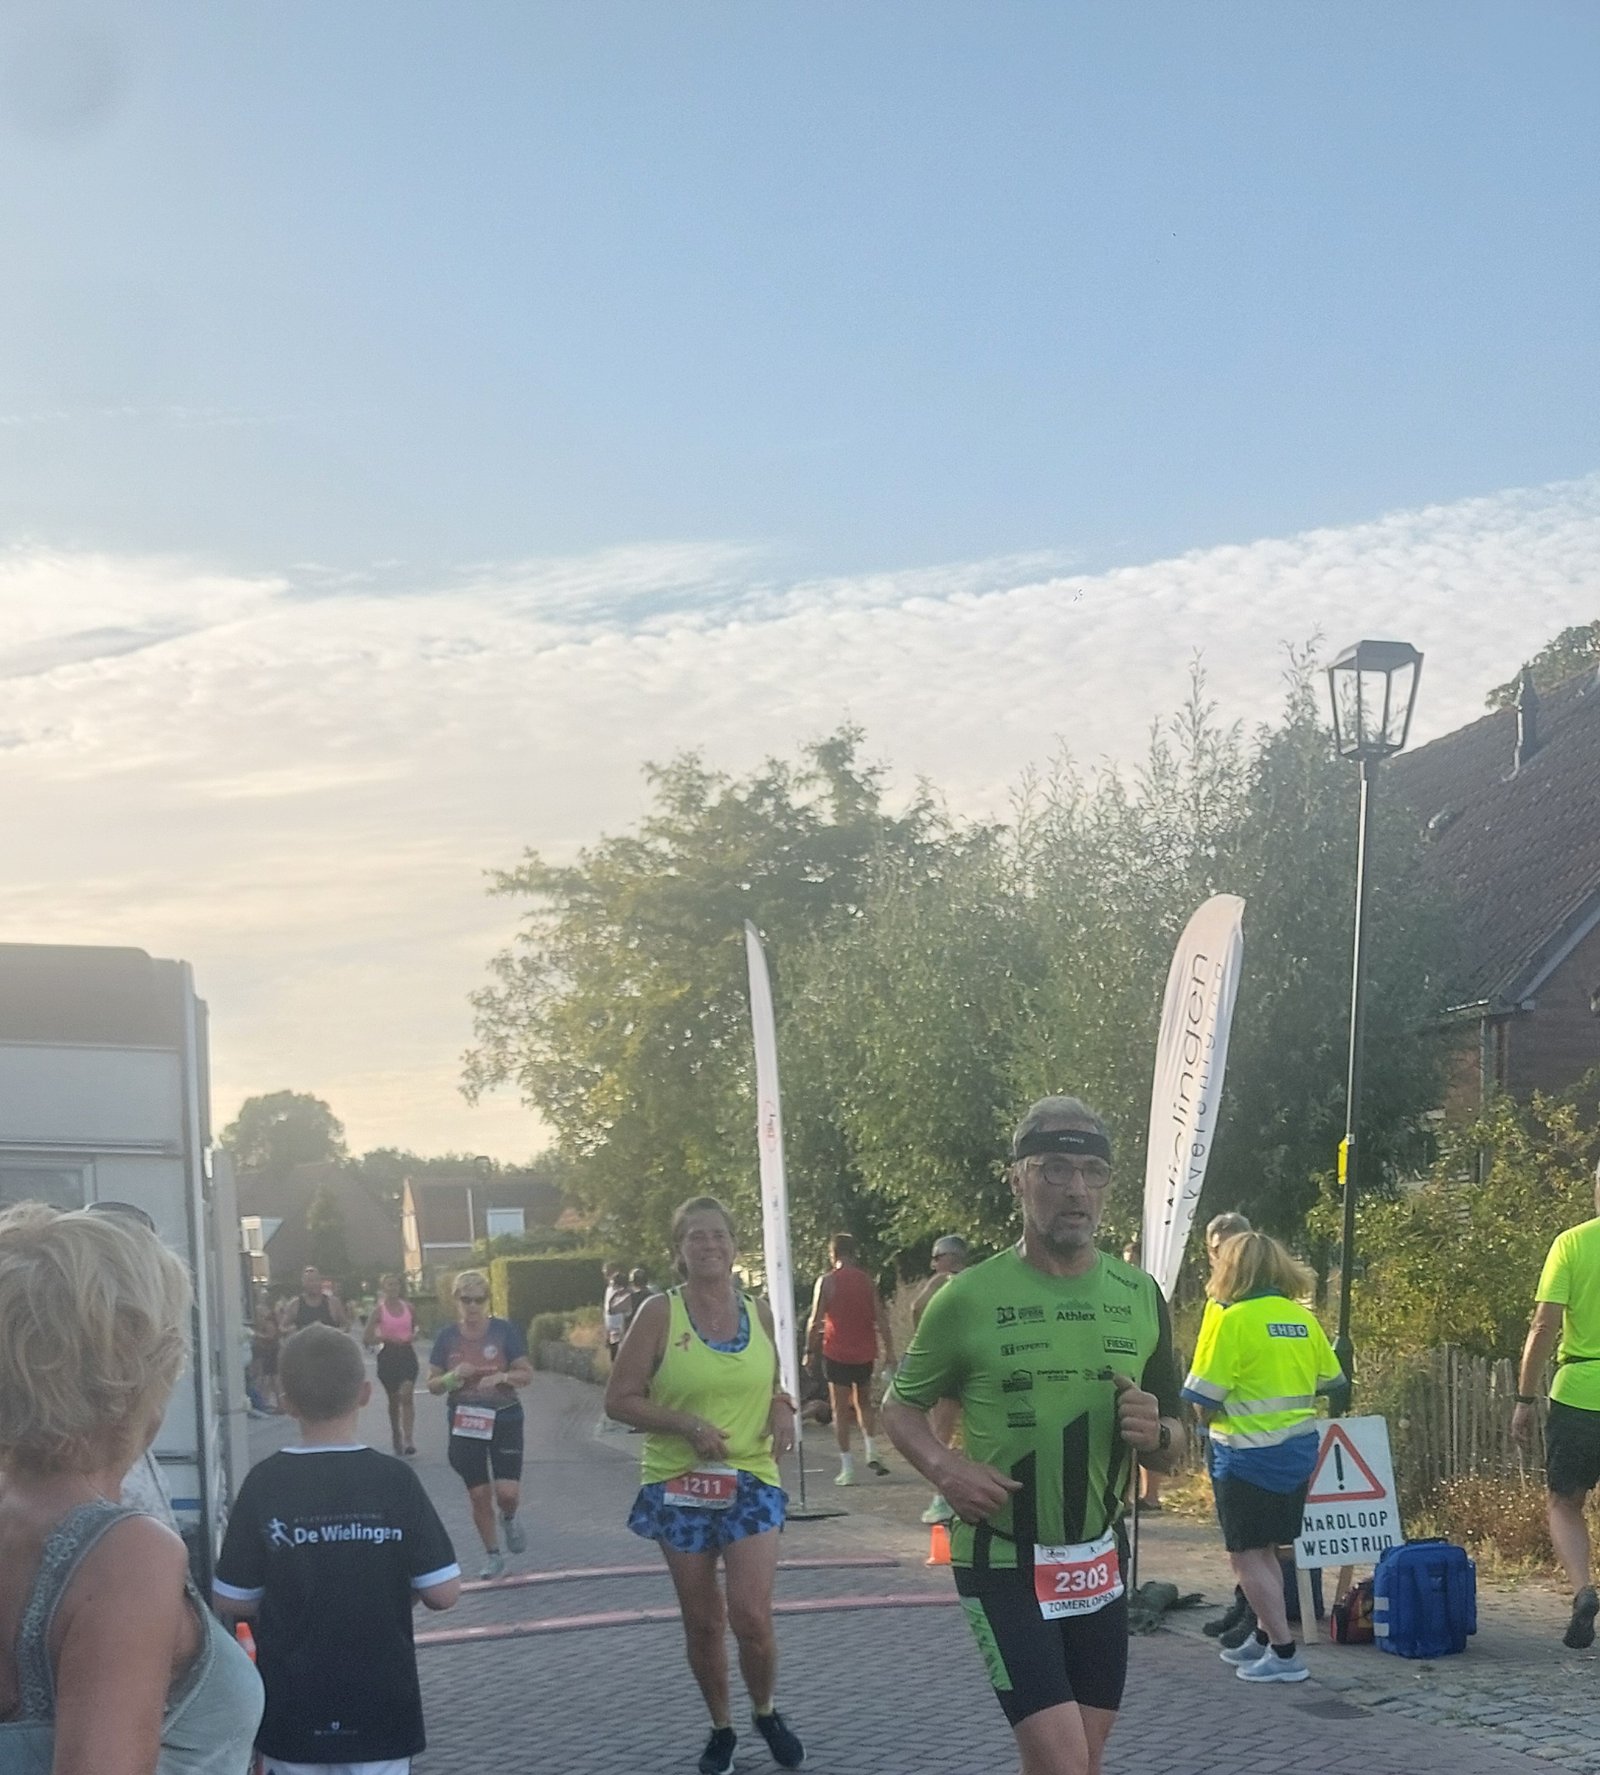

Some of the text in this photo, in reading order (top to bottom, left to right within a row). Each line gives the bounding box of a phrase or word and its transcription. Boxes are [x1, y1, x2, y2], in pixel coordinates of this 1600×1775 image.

[1056, 1310, 1097, 1322] Athlex
[1269, 1325, 1307, 1337] EHBO
[682, 1476, 721, 1495] 1211
[294, 1522, 403, 1544] De Wielingen
[1054, 1562, 1109, 1593] 2303
[1048, 1590, 1116, 1613] ZOMERLOPEN
